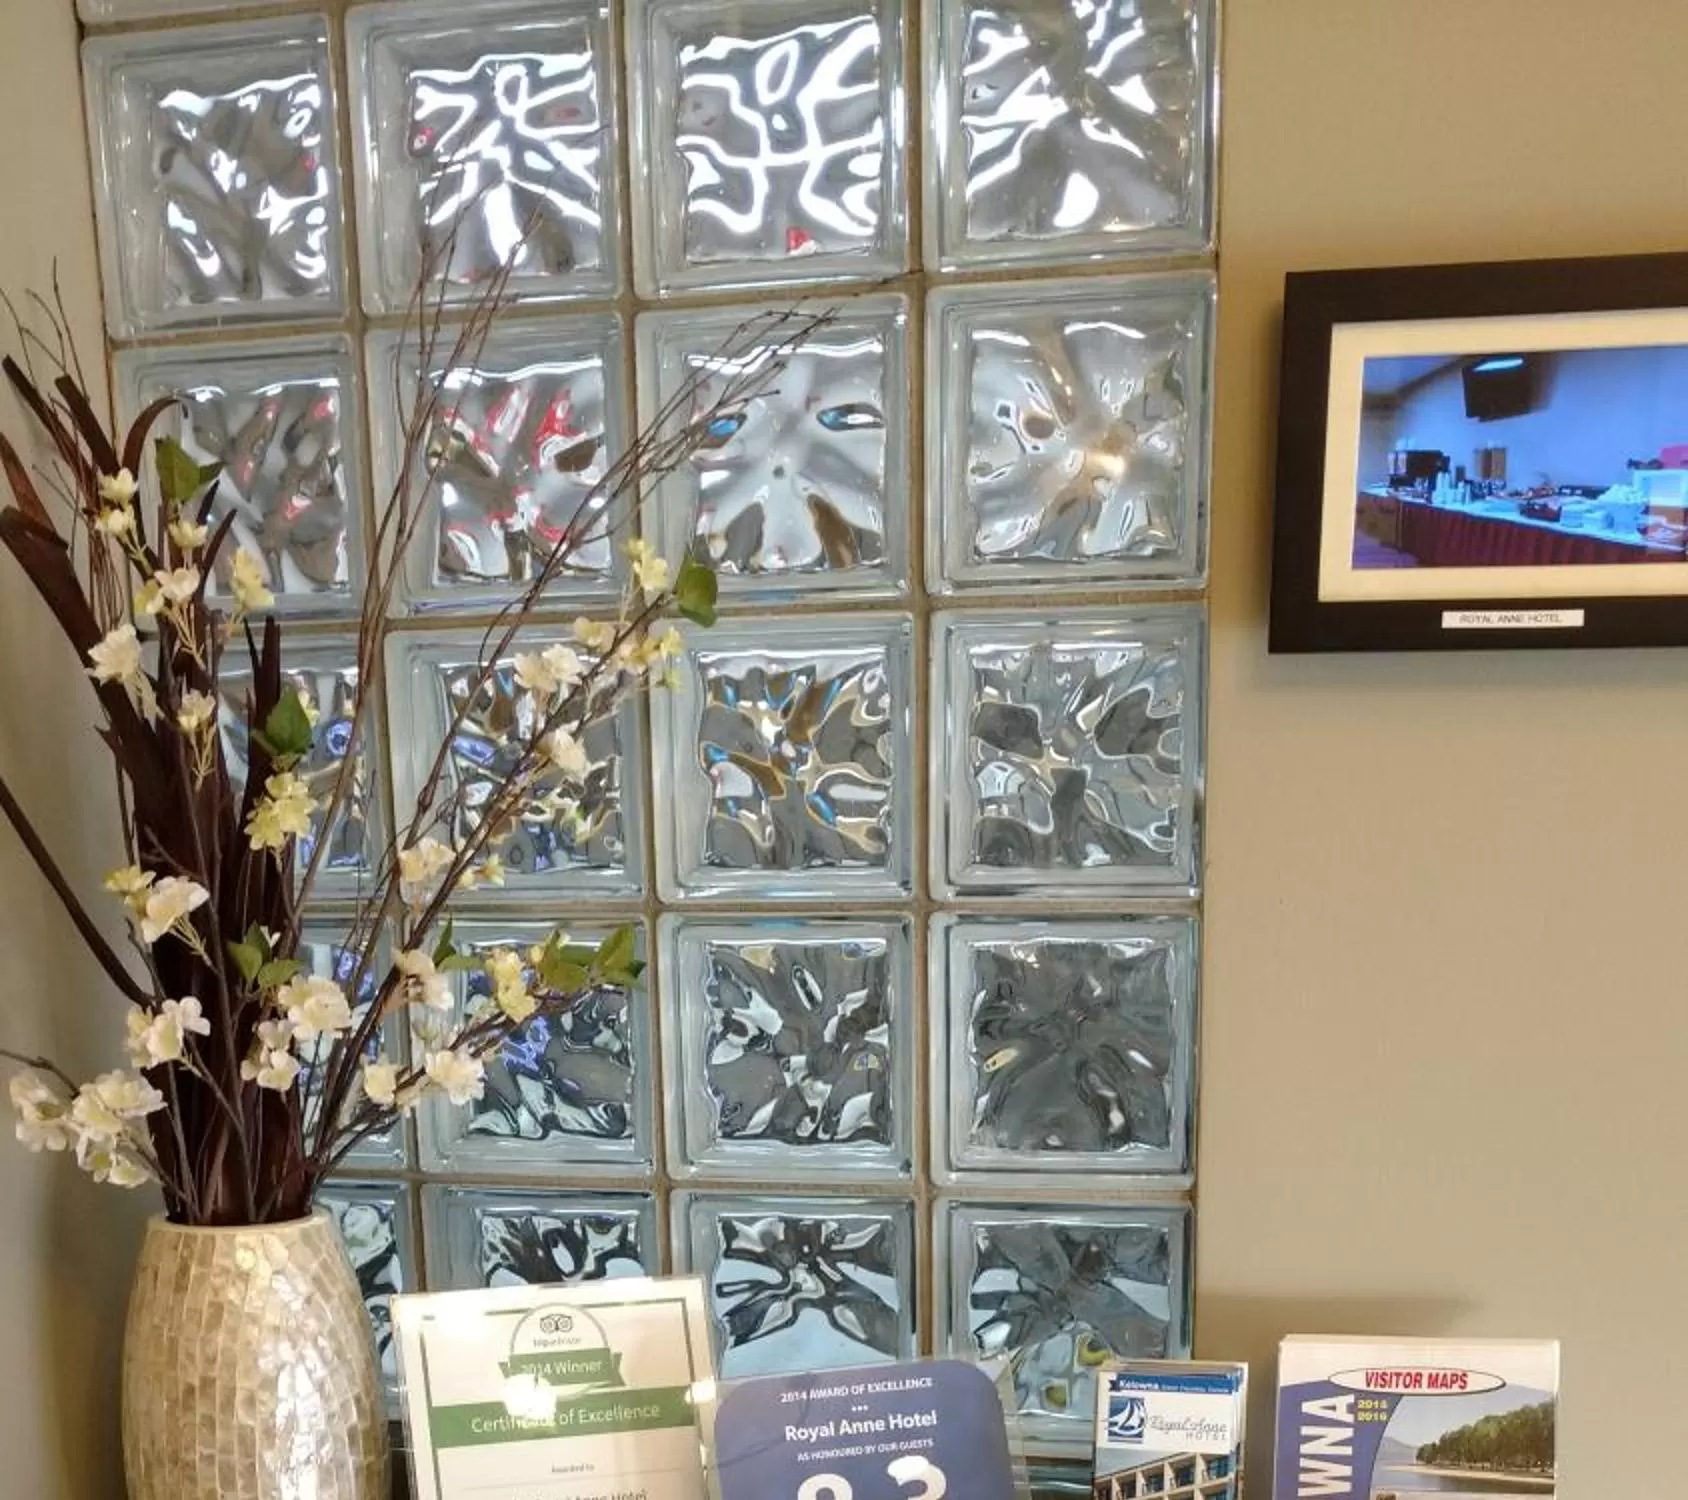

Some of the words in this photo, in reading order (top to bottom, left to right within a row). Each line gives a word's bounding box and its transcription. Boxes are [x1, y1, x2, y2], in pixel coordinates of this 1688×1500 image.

[551, 1358, 602, 1376] Winner
[780, 1391, 808, 1404] 2014
[809, 1385, 849, 1401] AWARD
[851, 1382, 866, 1395] OF
[867, 1376, 934, 1393] EXCELLENCE
[1365, 1371, 1423, 1389] VISITOR
[1426, 1371, 1469, 1390] MAPS
[470, 1409, 557, 1434] Certific
[559, 1408, 576, 1426] of
[578, 1402, 662, 1424] Excellence
[785, 1420, 836, 1444] Royal
[839, 1416, 886, 1437] Anne
[888, 1409, 938, 1431] Hotel
[1185, 1431, 1227, 1441] HOTEL
[797, 1450, 811, 1462] AS
[877, 1443, 897, 1453] OUR
[898, 1437, 935, 1452] GUESTS
